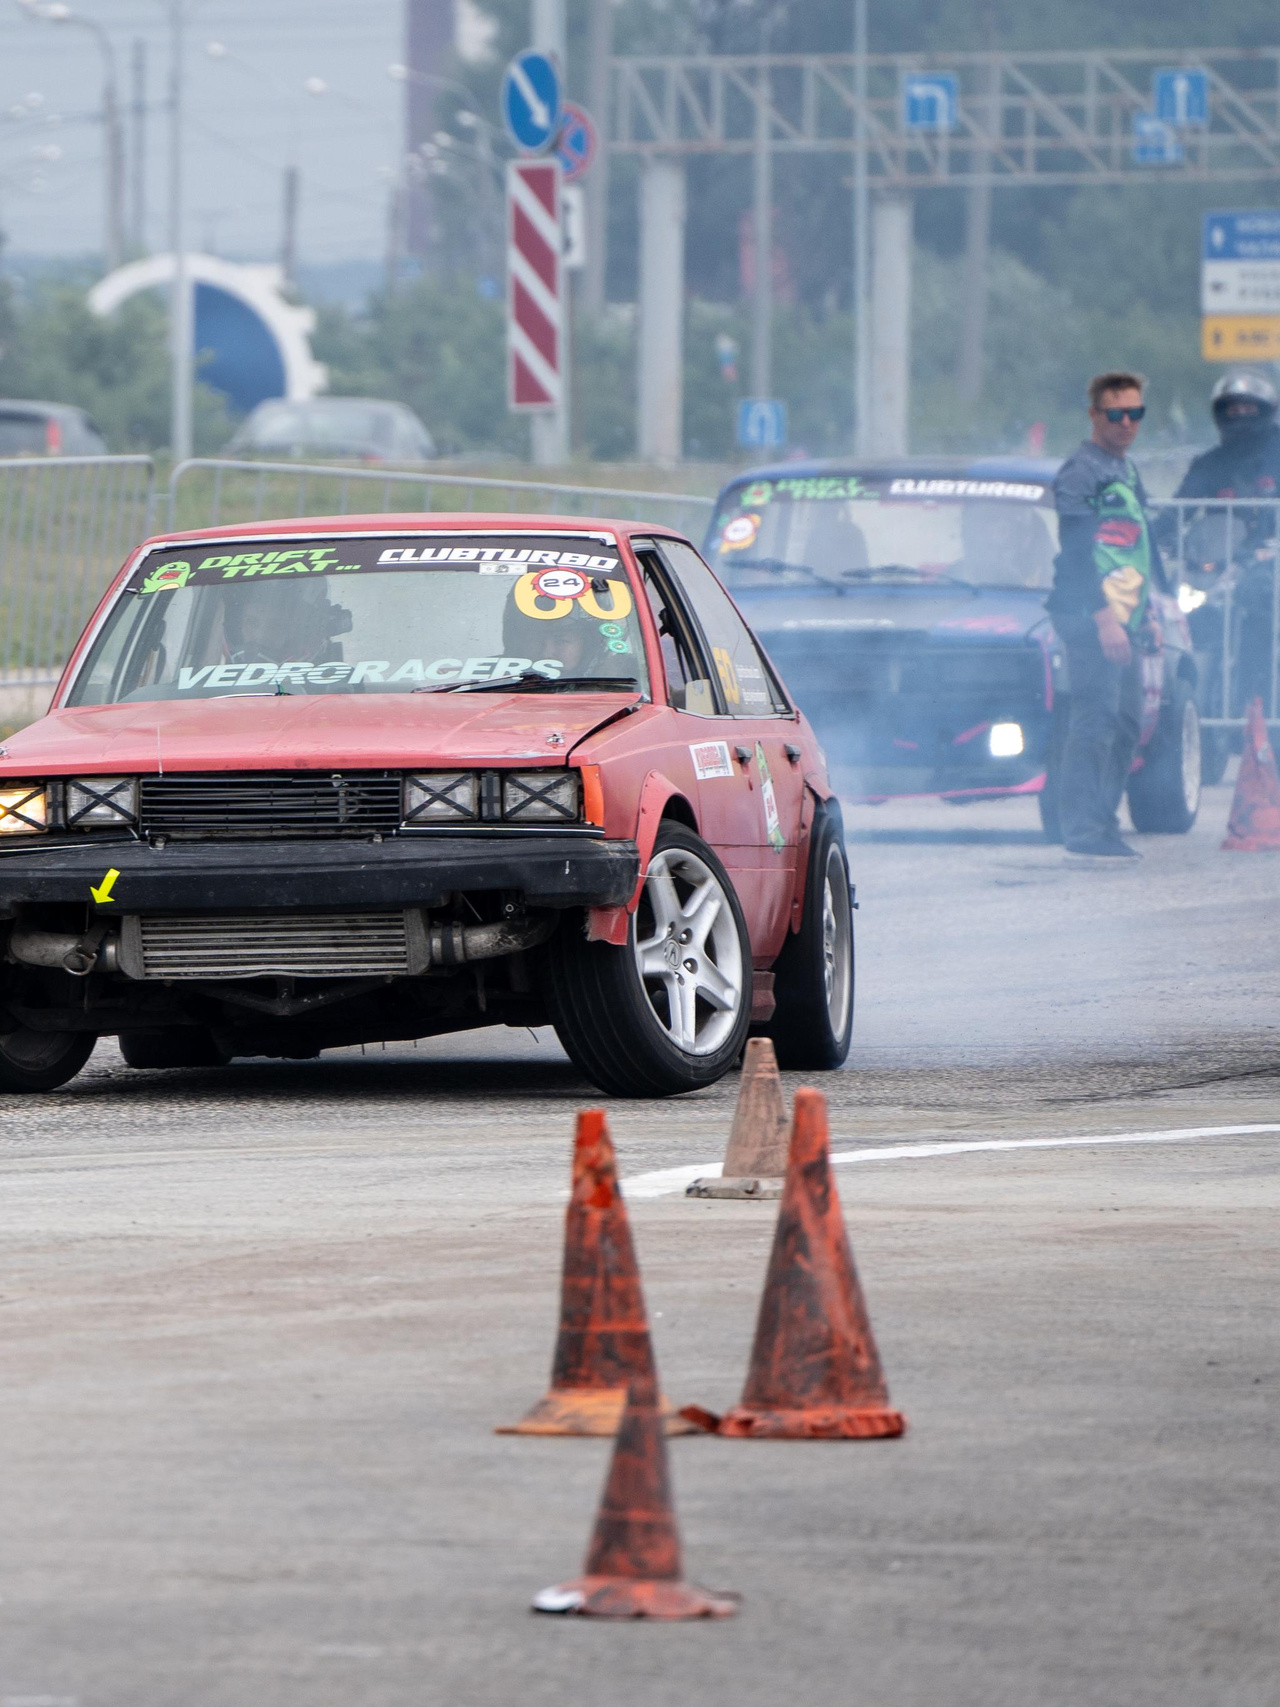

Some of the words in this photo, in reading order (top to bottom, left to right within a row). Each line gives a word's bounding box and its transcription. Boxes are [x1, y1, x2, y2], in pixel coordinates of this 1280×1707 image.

[197, 548, 337, 570] DRIFT
[377, 547, 619, 571] CLUBTURBO
[542, 577, 581, 588] 24
